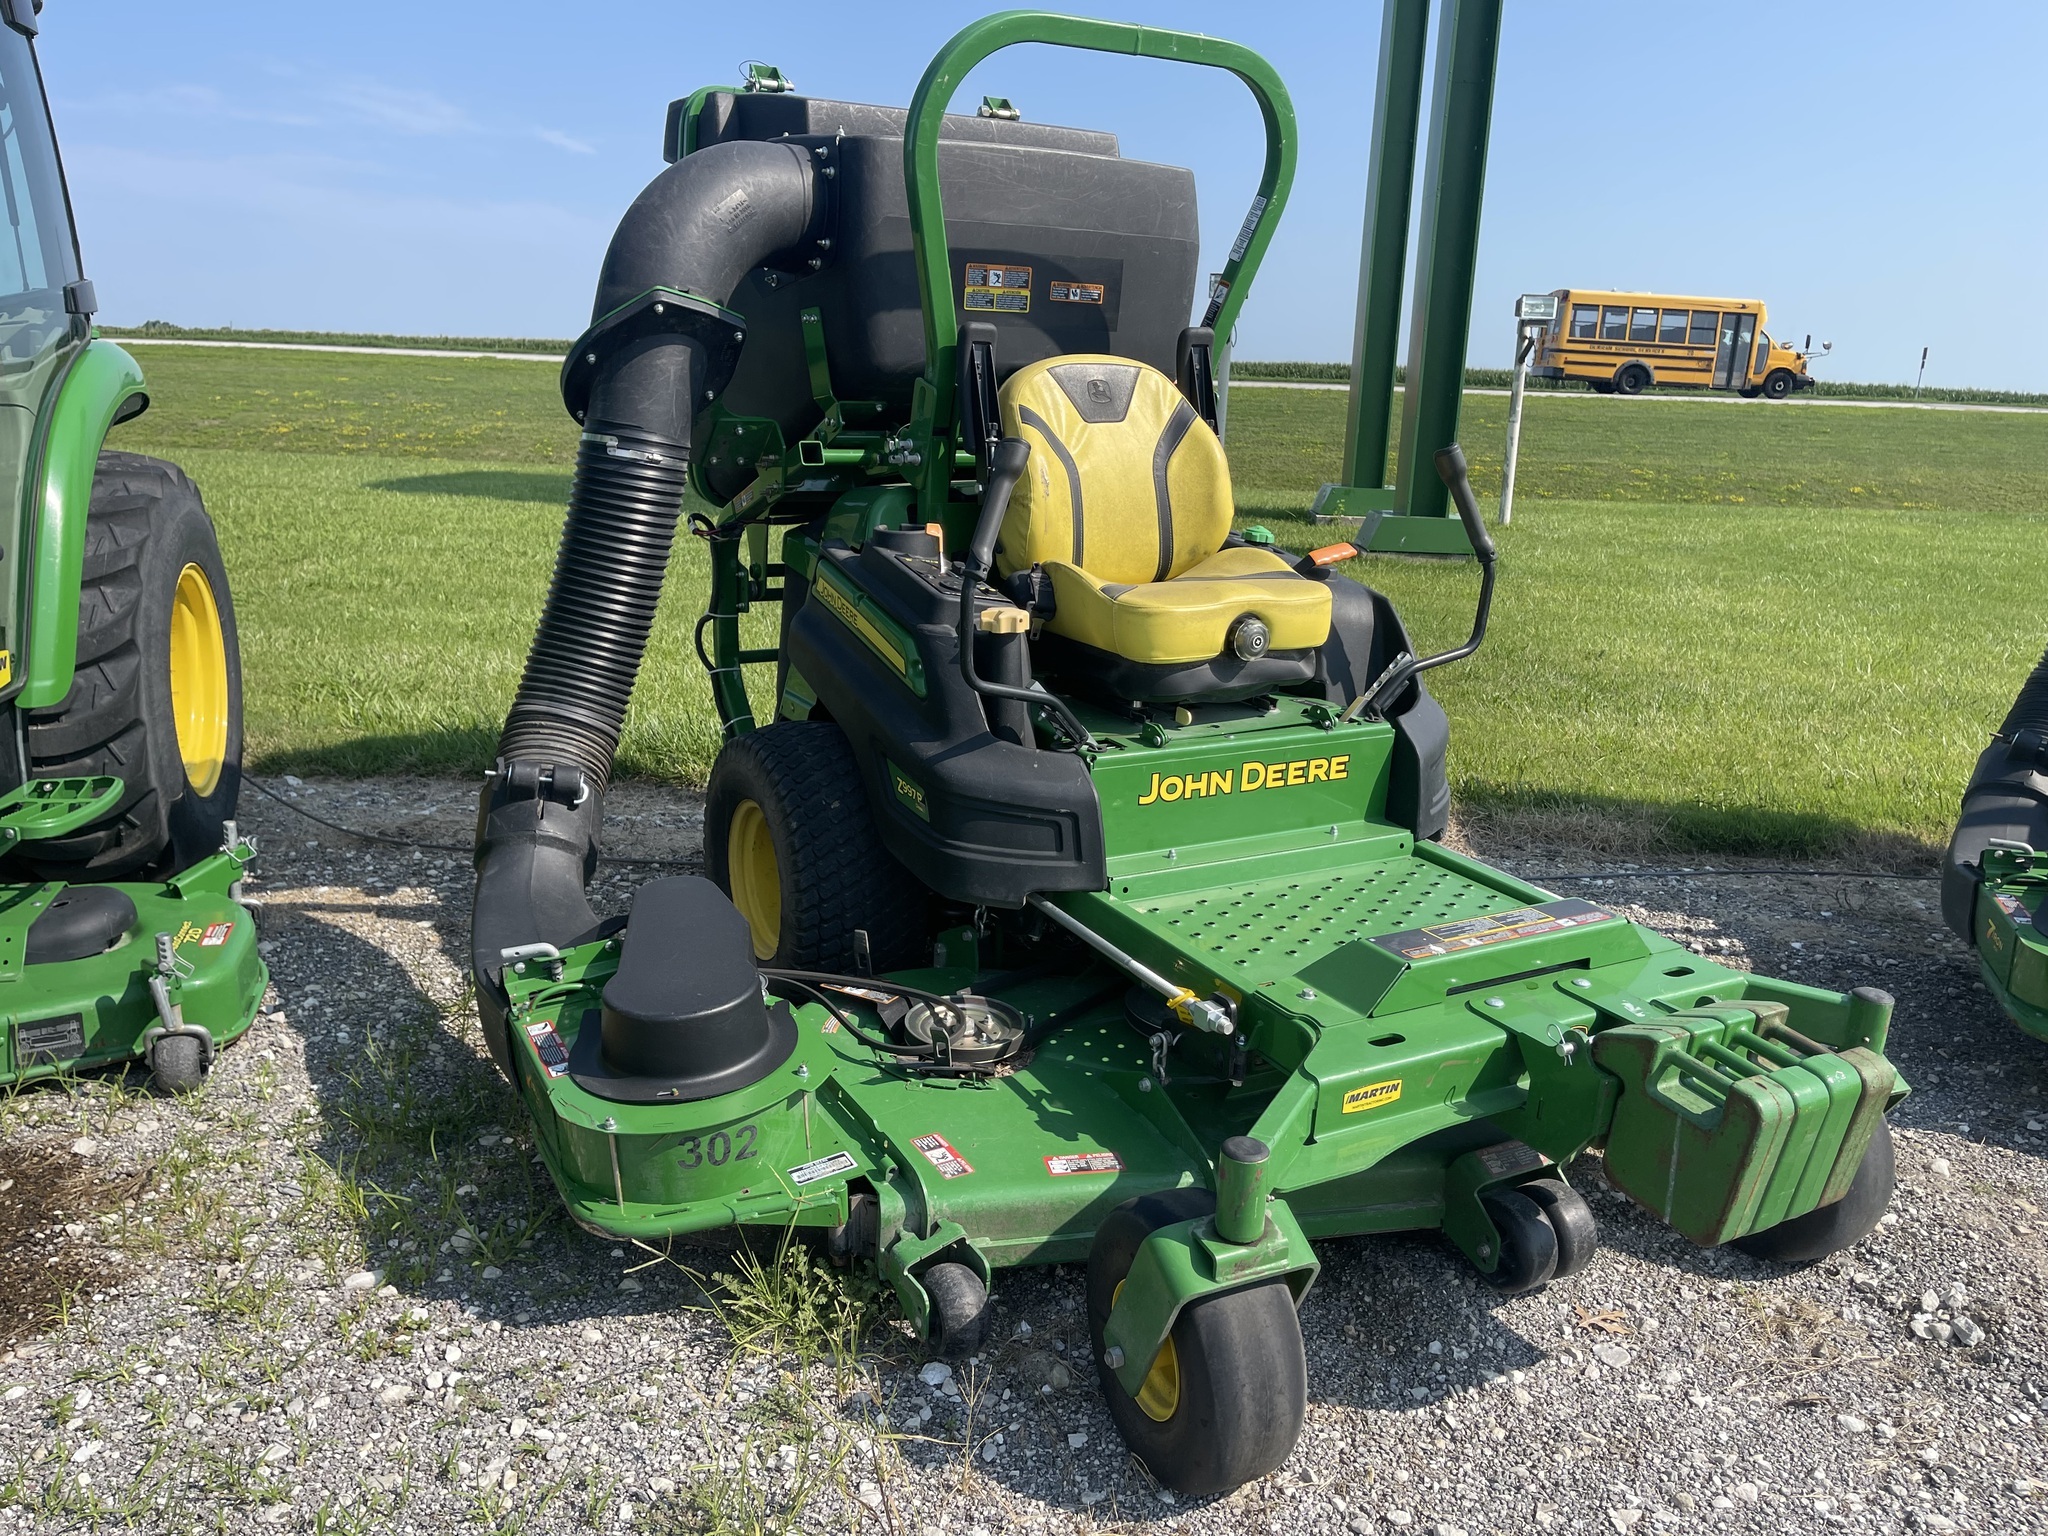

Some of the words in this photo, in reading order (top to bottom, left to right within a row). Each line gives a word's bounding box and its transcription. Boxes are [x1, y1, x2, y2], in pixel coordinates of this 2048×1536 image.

[836, 595, 859, 629] DEERE
[1138, 769, 1234, 806] JOHN
[1240, 754, 1351, 792] DEERE
[1346, 1082, 1401, 1104] MARTIN
[677, 1124, 759, 1170] 302
